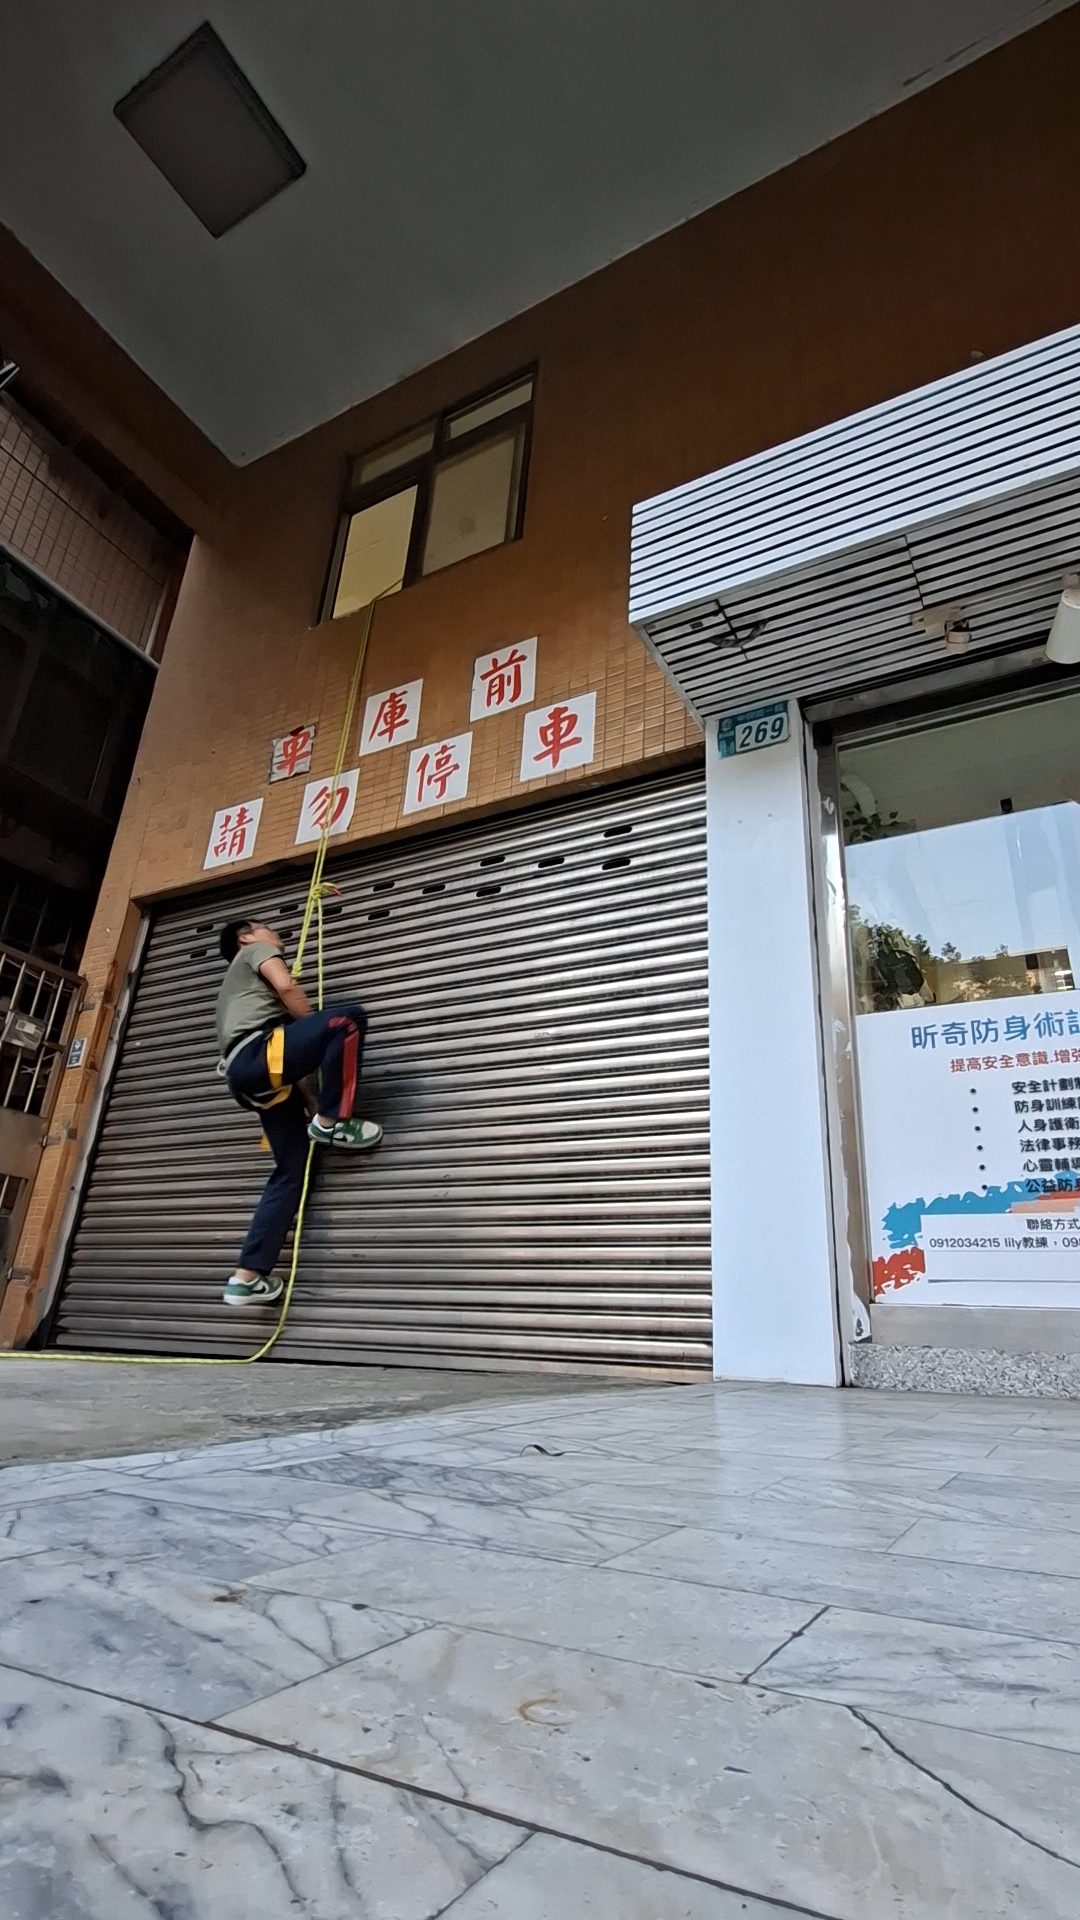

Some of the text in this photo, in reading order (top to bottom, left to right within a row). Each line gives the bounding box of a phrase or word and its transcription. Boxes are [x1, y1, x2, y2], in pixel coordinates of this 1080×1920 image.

[740, 717, 784, 748] 269
[214, 707, 583, 857] 請勿停車
[1014, 1096, 1080, 1113] 防身訓練
[929, 1237, 1000, 1248] 0912034215
